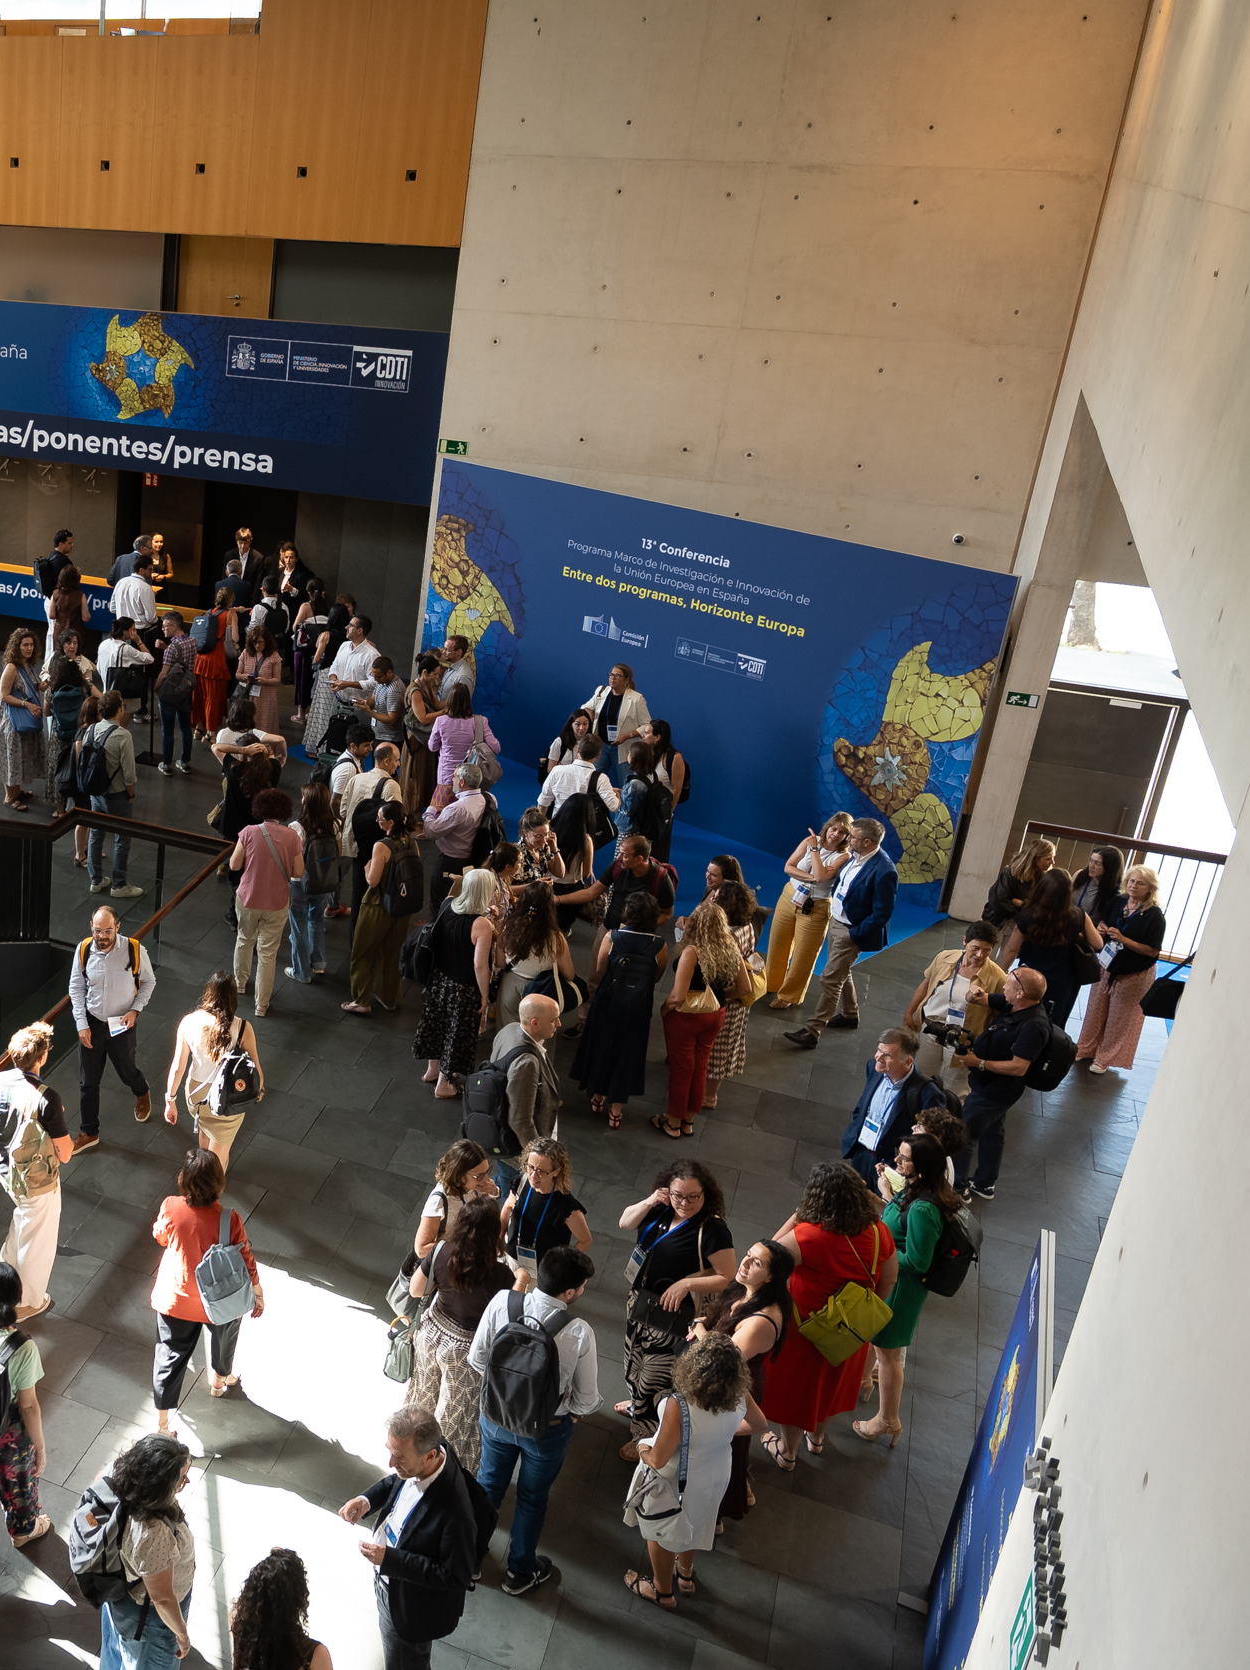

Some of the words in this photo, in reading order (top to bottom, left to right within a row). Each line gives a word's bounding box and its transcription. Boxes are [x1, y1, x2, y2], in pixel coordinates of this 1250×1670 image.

[318, 362, 348, 370] INNOVACIÓN
[376, 355, 408, 380] CDTI
[374, 379, 406, 390] INNOVACIÓN
[641, 538, 657, 550] 13ª
[659, 542, 731, 568] Conferencia
[568, 539, 613, 558] Programa
[614, 550, 643, 566] Marco
[644, 558, 658, 569] de
[659, 561, 725, 585] Investigación
[726, 579, 734, 588] e
[735, 579, 794, 602] Innovación
[795, 594, 811, 606] de
[613, 563, 622, 574] la
[623, 565, 652, 582] Unión
[654, 573, 695, 592] Europea
[696, 585, 710, 596] en
[712, 587, 750, 605] España
[562, 565, 593, 583] Entre
[595, 574, 616, 589] dos
[618, 582, 687, 609] programas,
[690, 598, 754, 624] Horizonte
[756, 614, 805, 638] Europa
[747, 660, 764, 675] CDTI
[680, 1446, 688, 1470] DEVOTA
